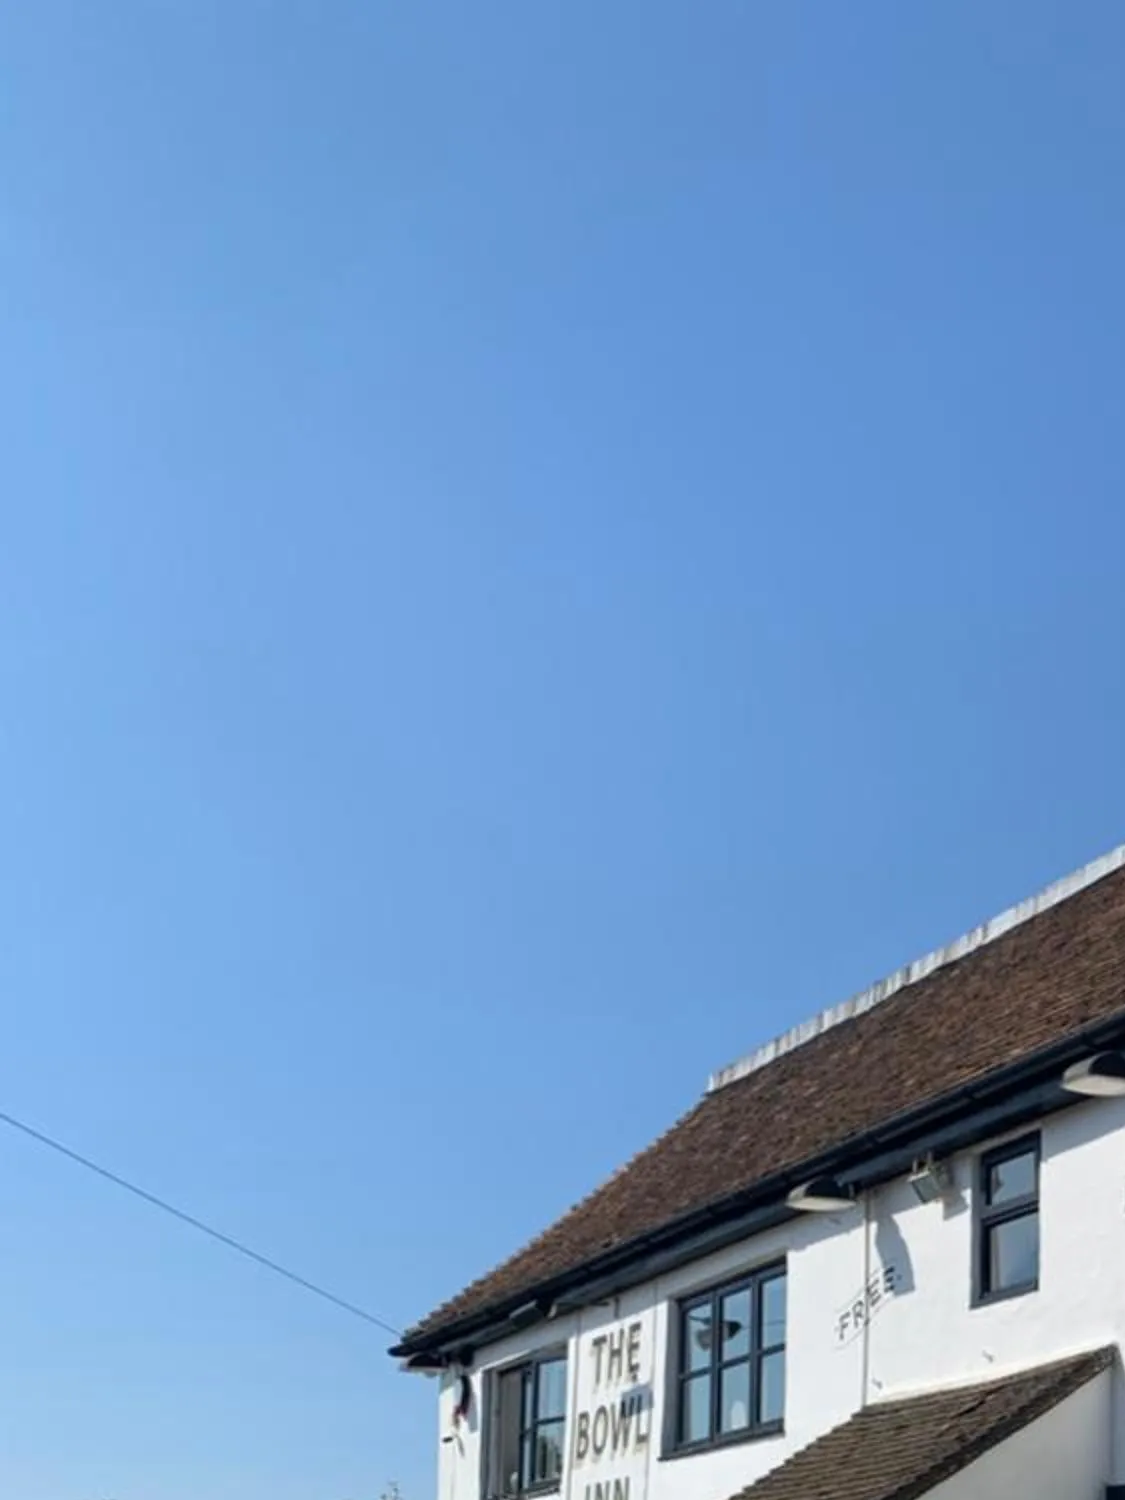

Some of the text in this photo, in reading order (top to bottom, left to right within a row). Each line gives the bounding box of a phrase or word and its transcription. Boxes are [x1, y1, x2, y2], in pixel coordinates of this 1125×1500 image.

[838, 1266, 896, 1341] FREE
[591, 1321, 642, 1386] THE
[576, 1394, 649, 1460] BOWL
